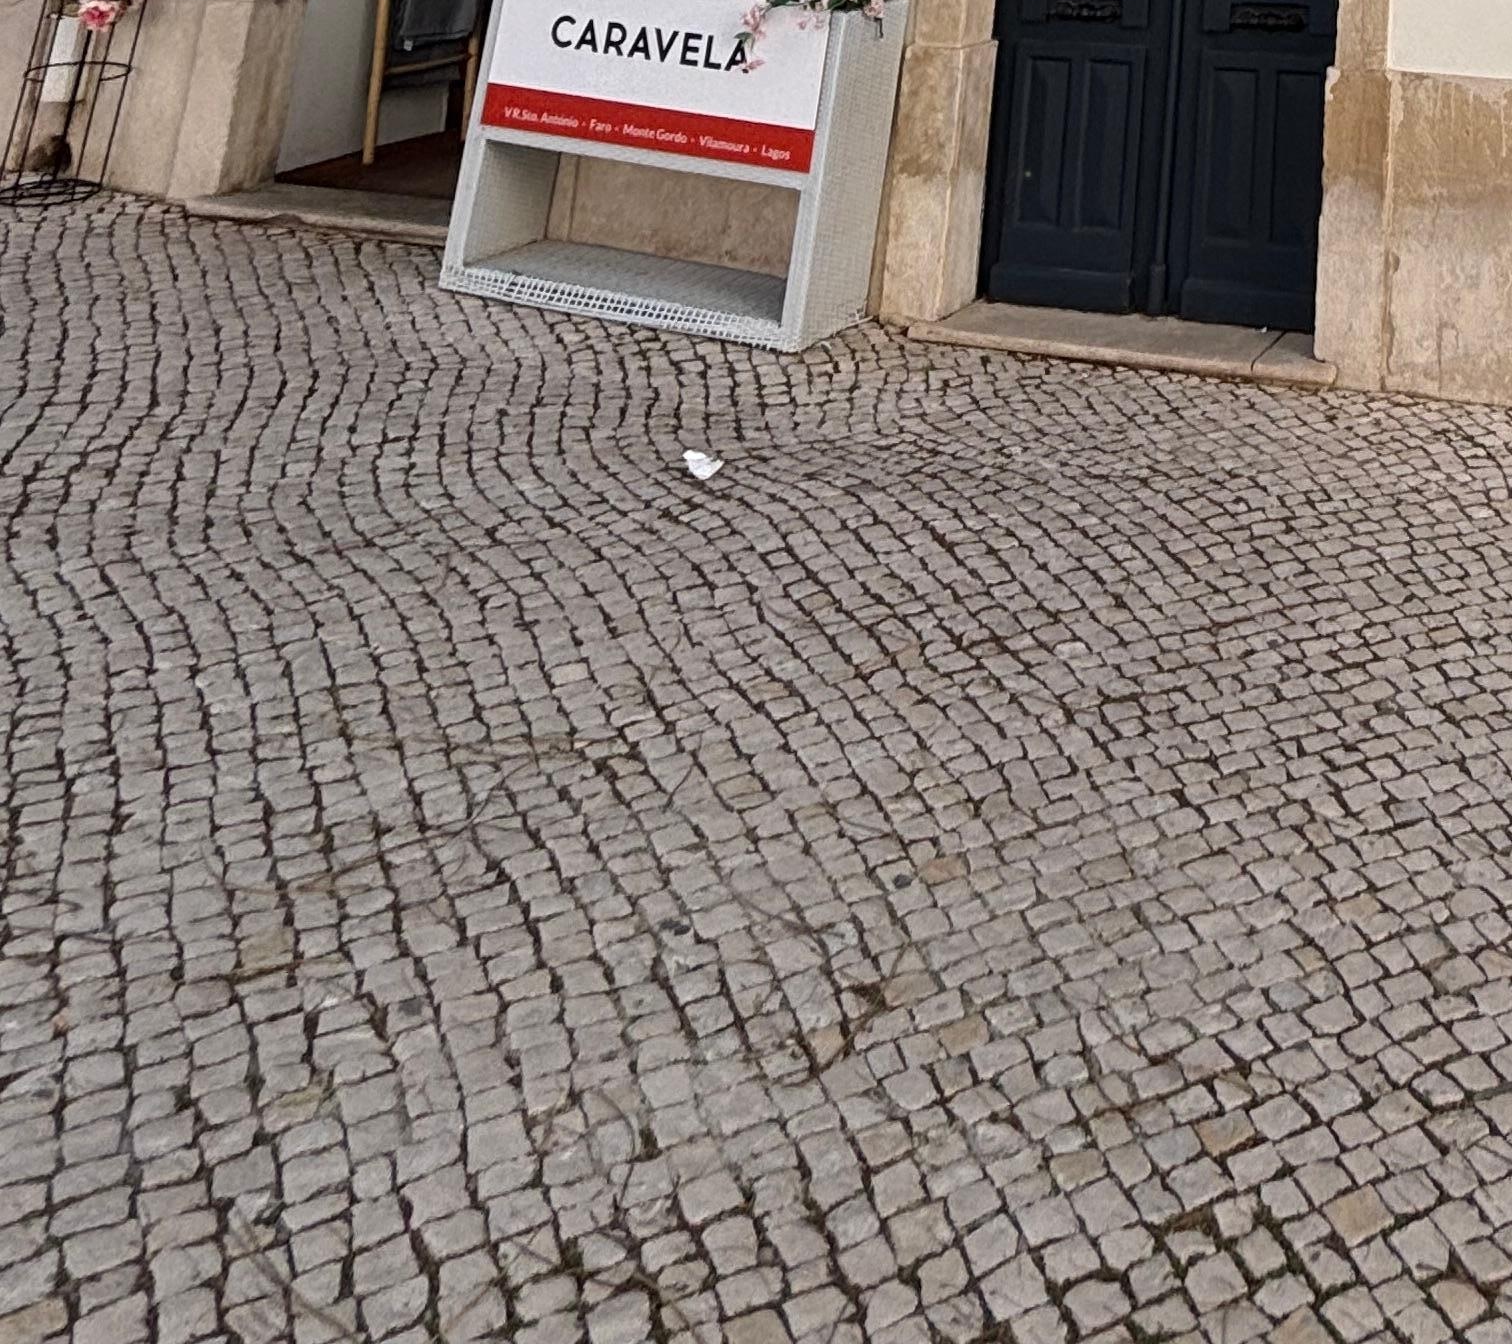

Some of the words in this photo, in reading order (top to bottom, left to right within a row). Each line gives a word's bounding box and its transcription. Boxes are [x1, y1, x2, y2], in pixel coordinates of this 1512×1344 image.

[551, 15, 749, 74] CARAVELA
[589, 118, 612, 134] Faro
[622, 123, 655, 140] Monte
[655, 128, 688, 144] Gordo
[699, 135, 751, 154] Vilamoura
[760, 144, 792, 161] Lagos
